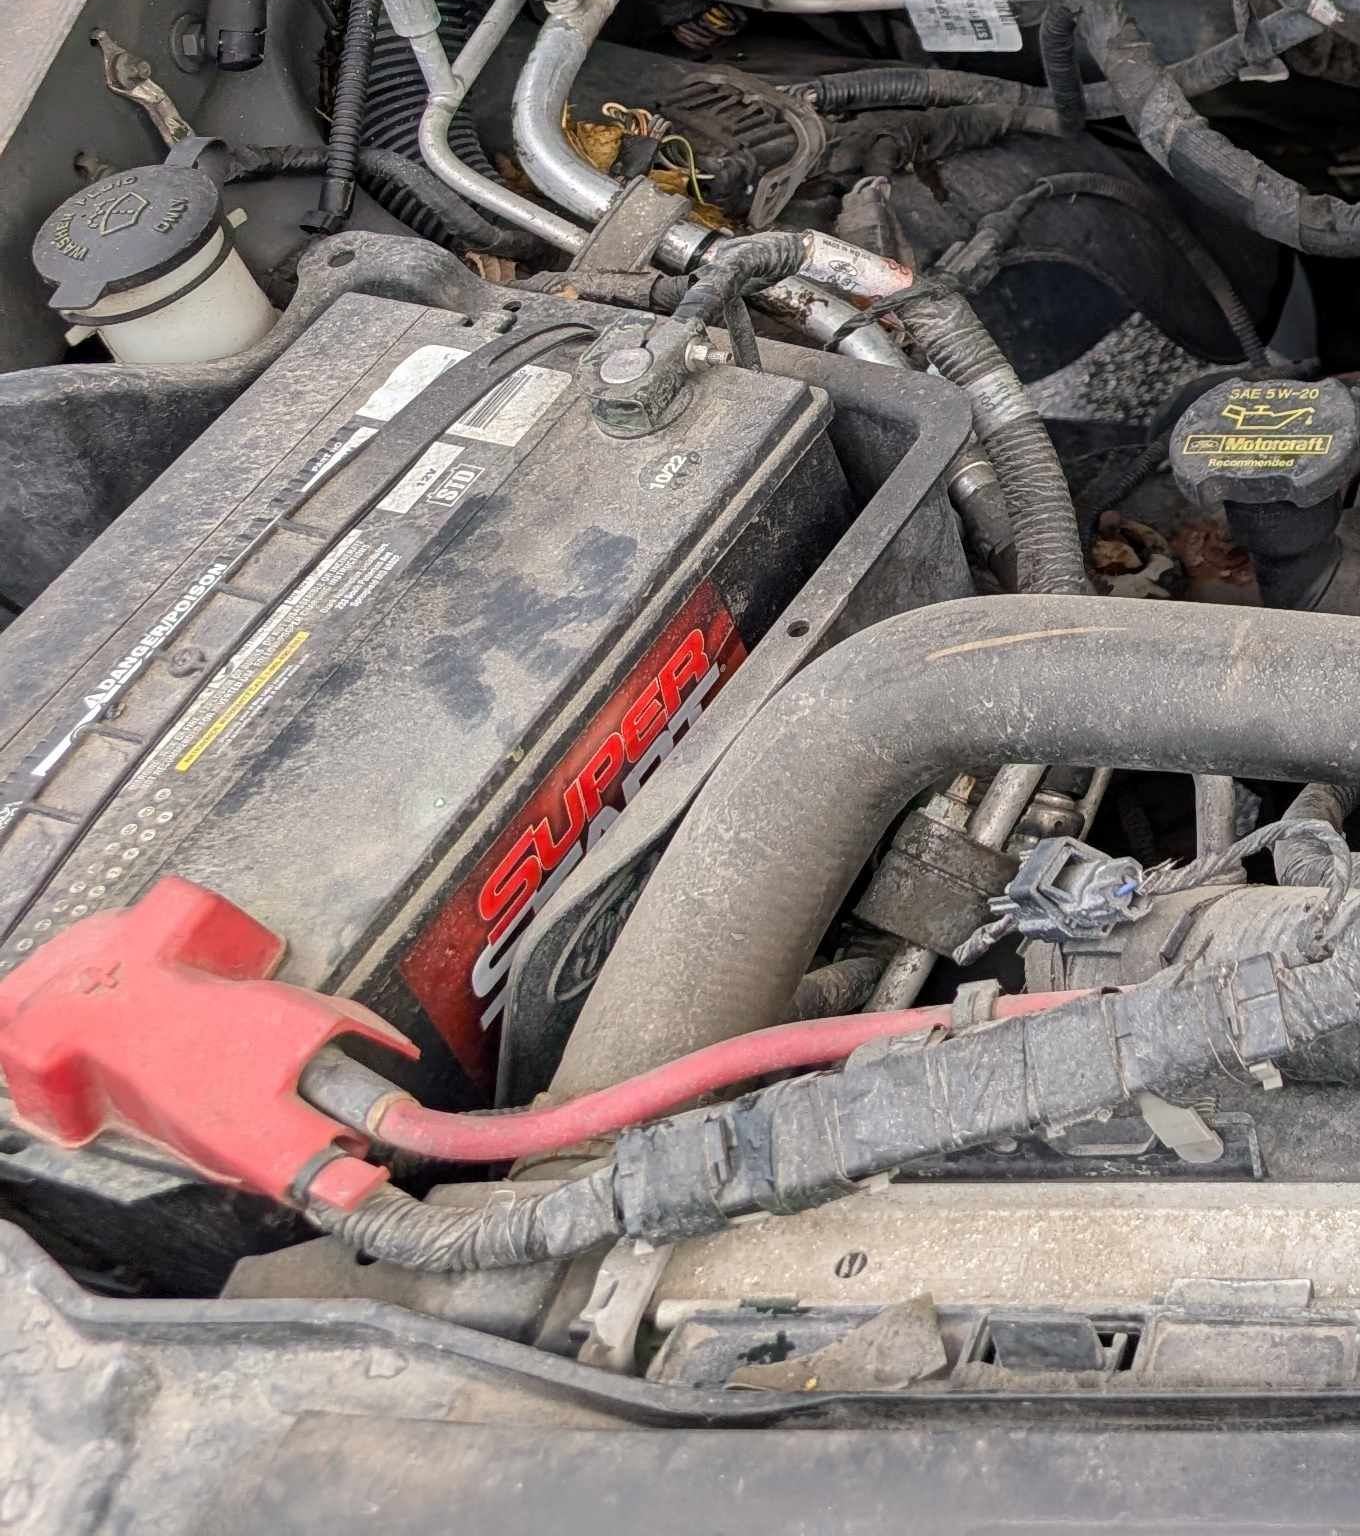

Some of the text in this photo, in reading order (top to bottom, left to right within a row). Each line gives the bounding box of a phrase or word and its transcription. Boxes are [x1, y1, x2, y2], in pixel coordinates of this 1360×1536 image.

[76, 174, 139, 207] FLUID
[153, 195, 190, 234] ONLY
[51, 212, 90, 262] WASHER
[1229, 388, 1320, 400] SAE 5W-20
[1224, 436, 1328, 452] Motorcraft
[415, 467, 438, 488] 12V
[650, 454, 687, 491] 10/22
[1207, 457, 1296, 468] Recommended
[437, 469, 476, 501] STD
[95, 562, 228, 693] DANGER/POISON
[479, 628, 710, 946] SUPER
